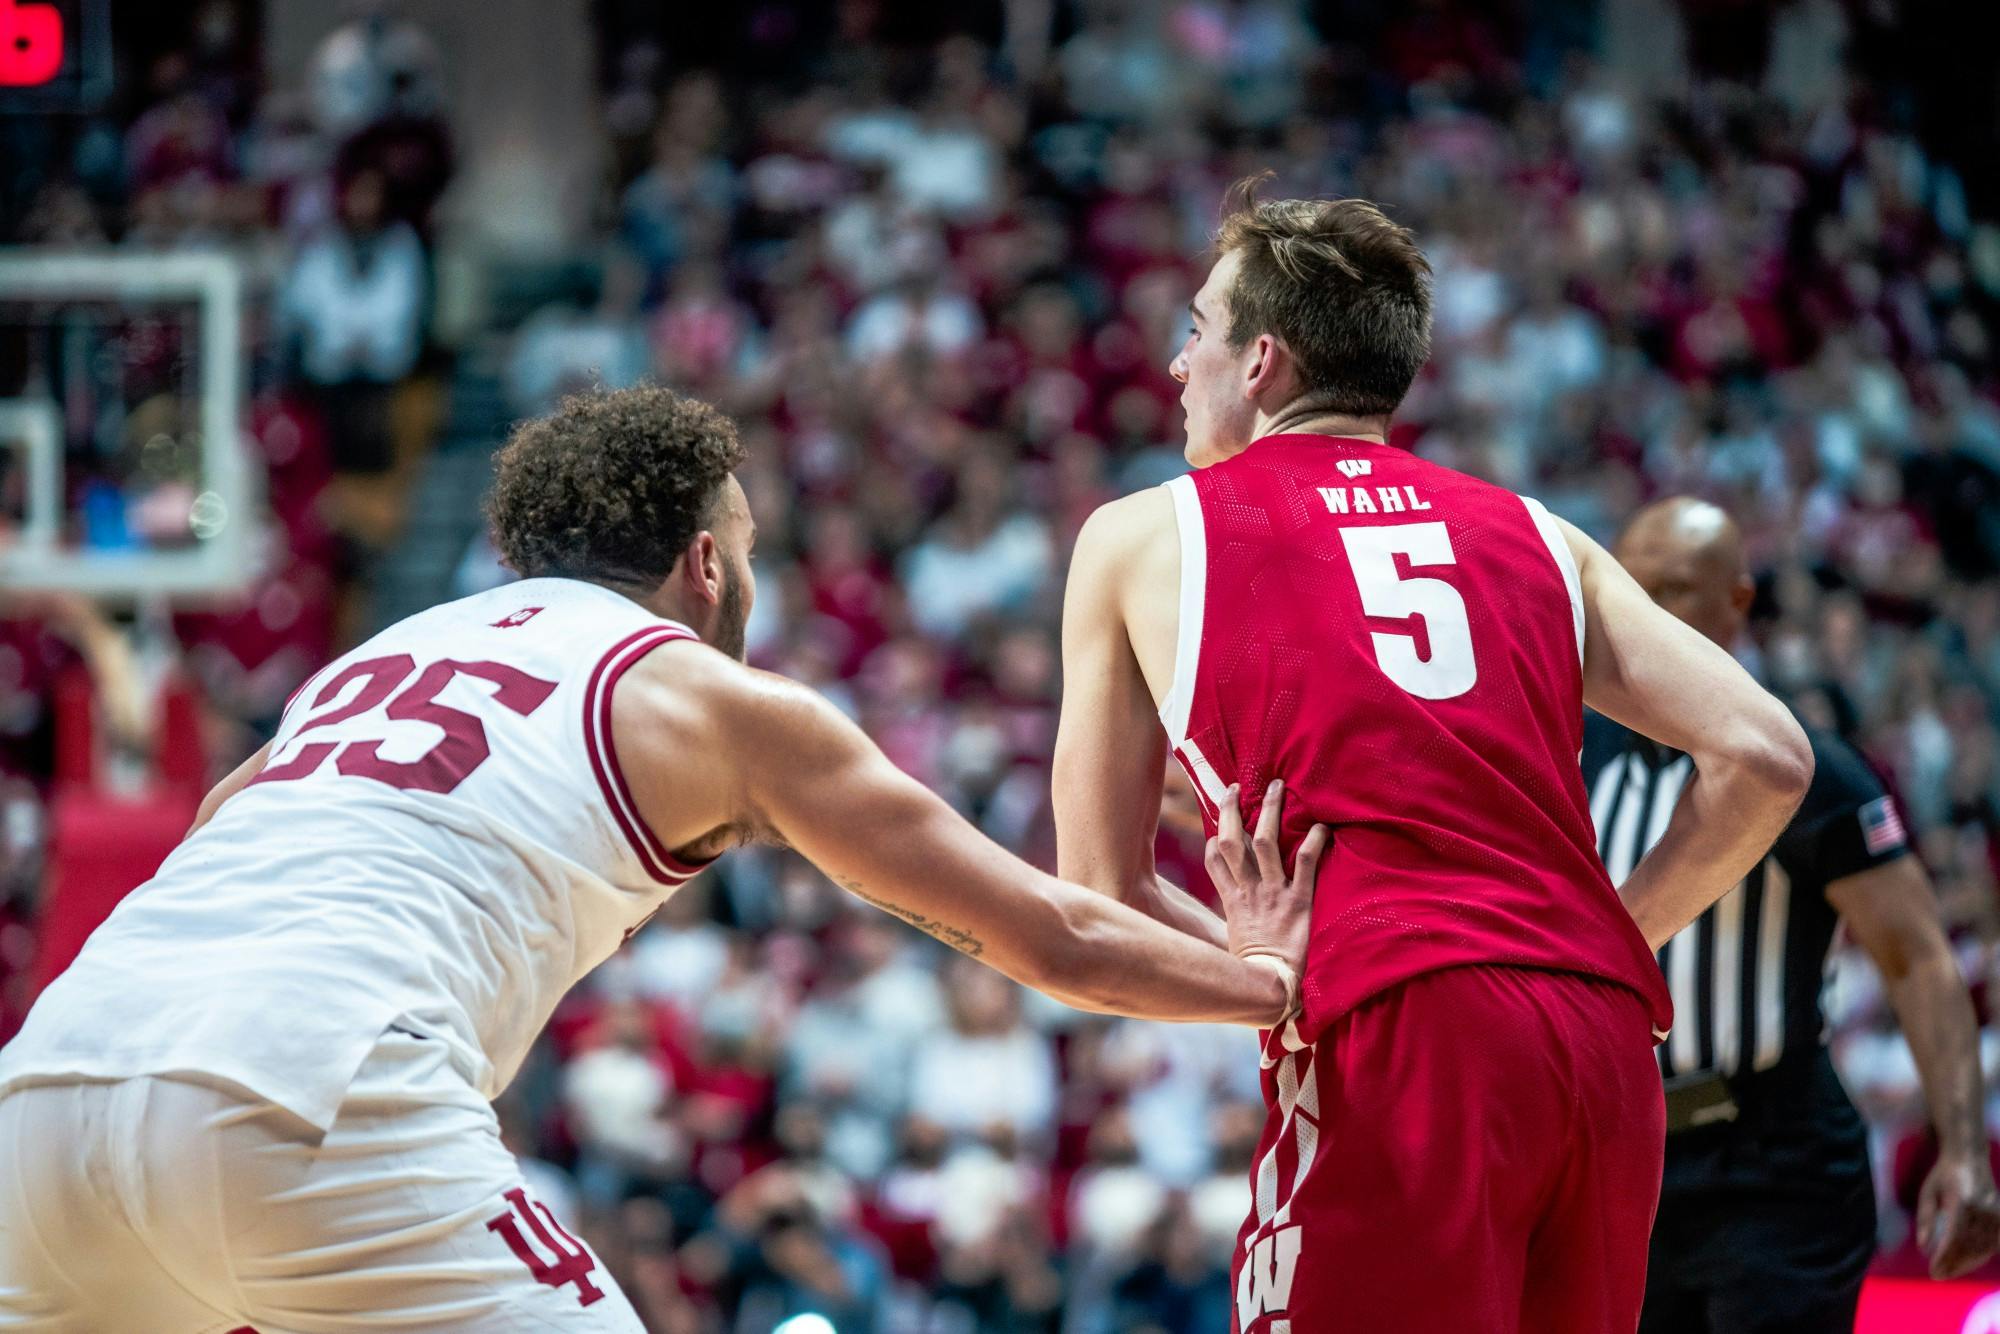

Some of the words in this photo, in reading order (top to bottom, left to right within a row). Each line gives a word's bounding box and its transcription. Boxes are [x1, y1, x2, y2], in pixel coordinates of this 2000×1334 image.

[1317, 485, 1432, 514] WAHL
[1335, 459, 1372, 479] W
[1338, 521, 1477, 700] 5
[243, 653, 560, 795] 25
[1236, 1225, 1302, 1334] W
